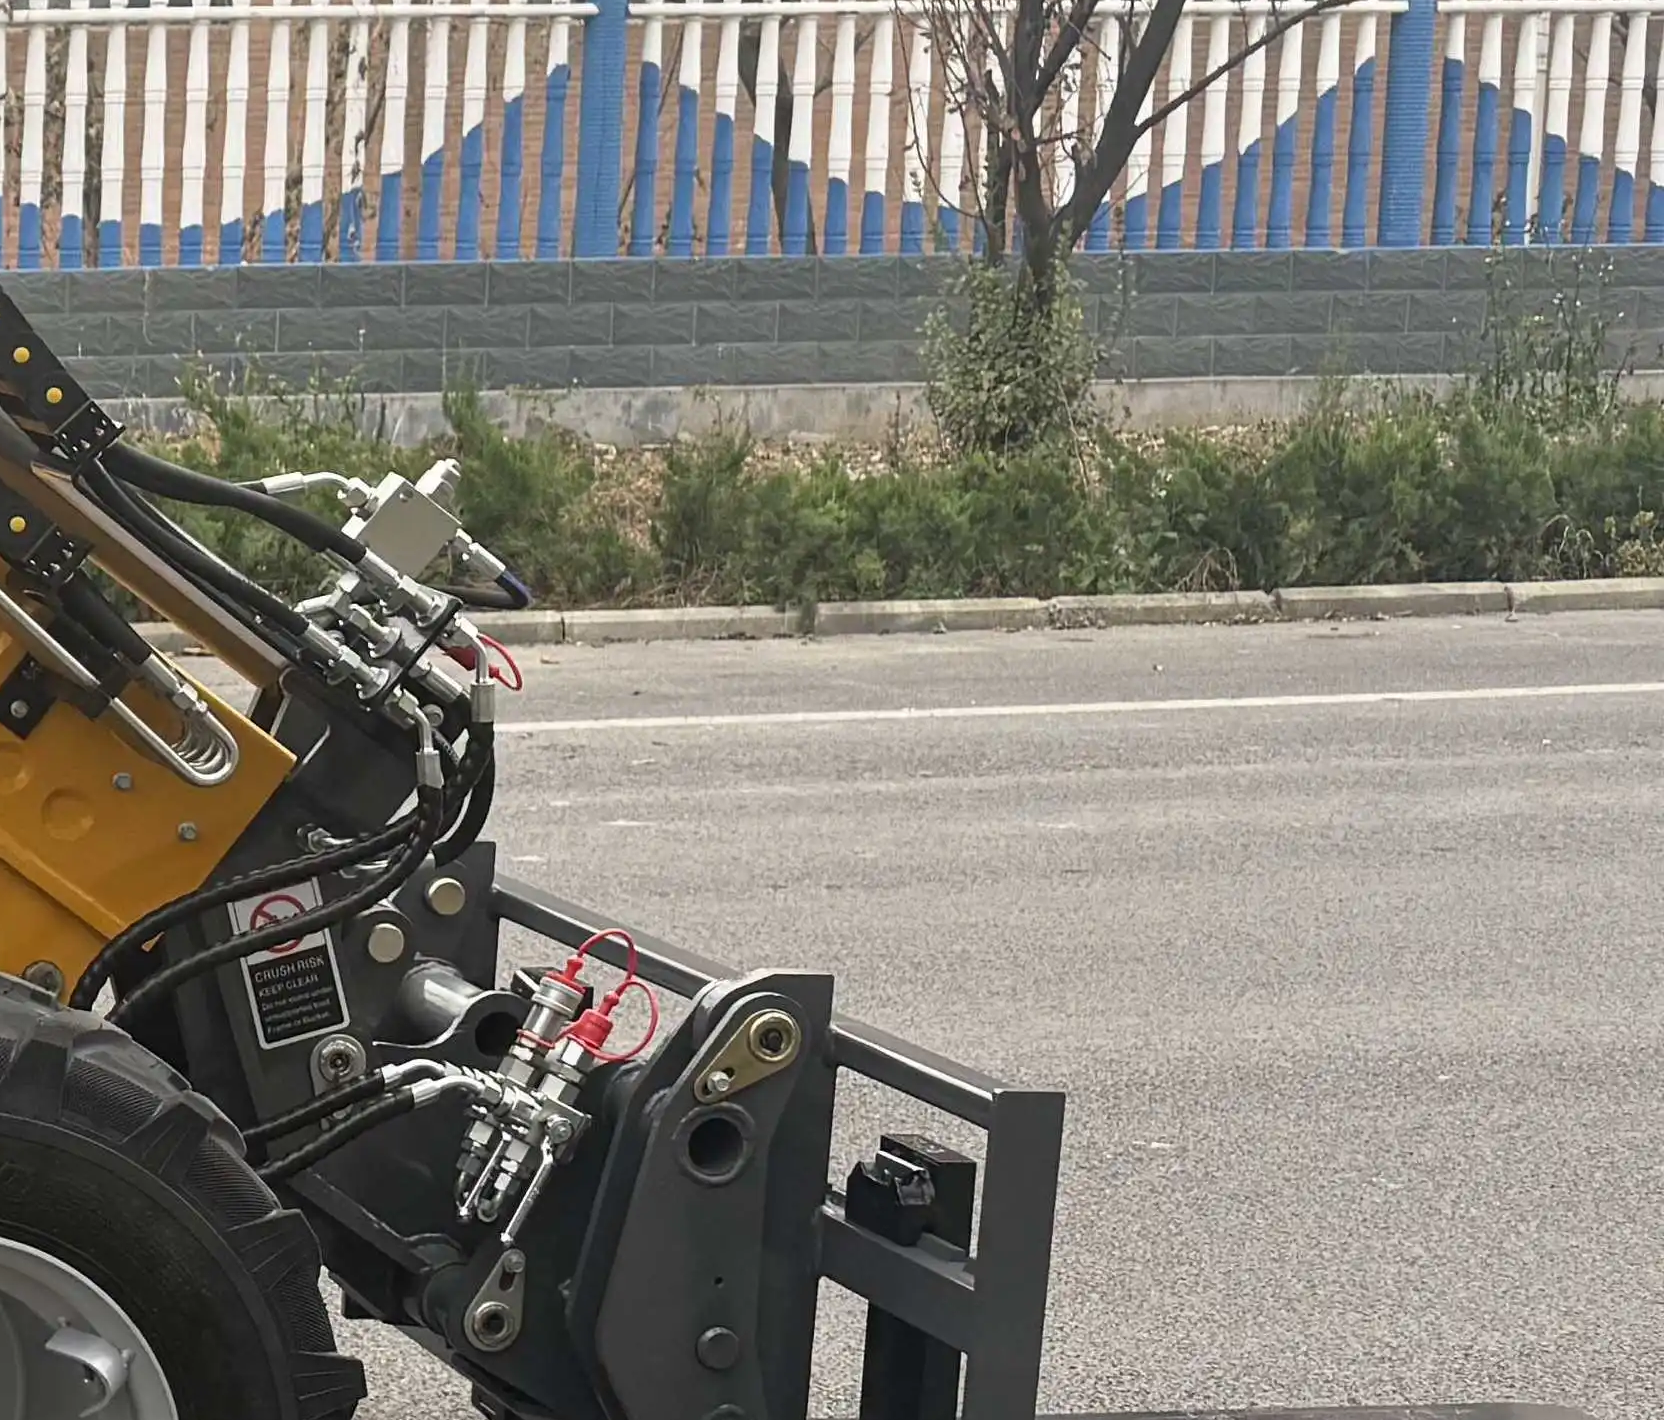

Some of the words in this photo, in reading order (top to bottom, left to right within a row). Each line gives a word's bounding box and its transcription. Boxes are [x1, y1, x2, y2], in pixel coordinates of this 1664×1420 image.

[255, 964, 296, 983] CRUSH
[297, 955, 325, 971] RISK
[258, 984, 285, 998] KEEP
[285, 974, 320, 990] CLEAR
